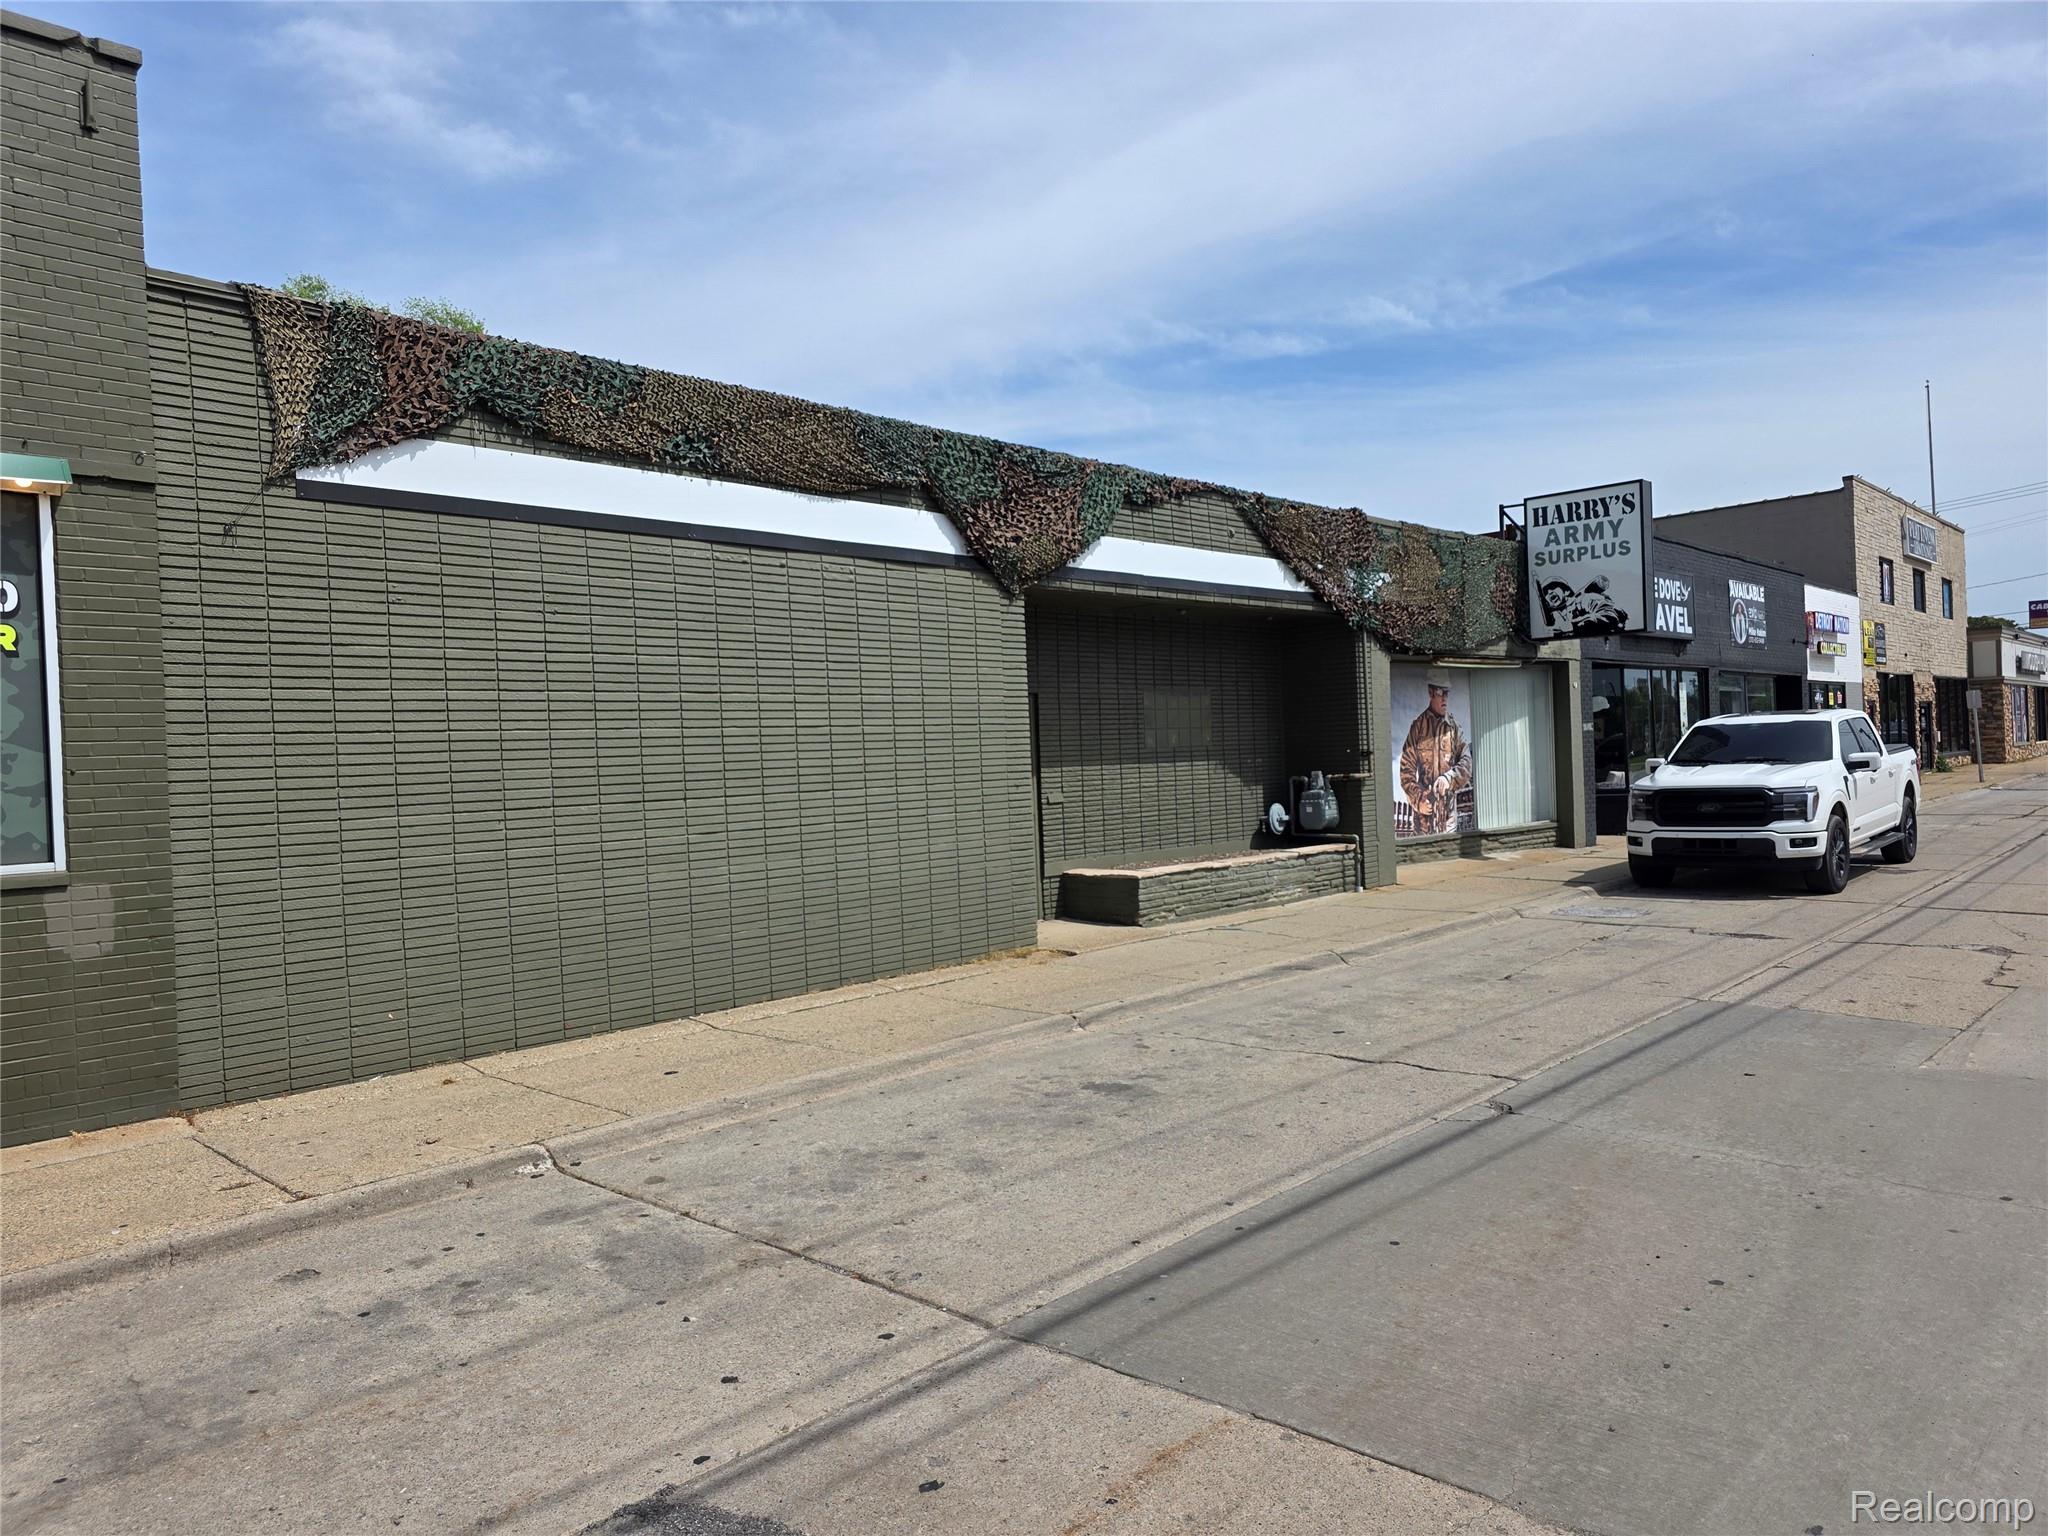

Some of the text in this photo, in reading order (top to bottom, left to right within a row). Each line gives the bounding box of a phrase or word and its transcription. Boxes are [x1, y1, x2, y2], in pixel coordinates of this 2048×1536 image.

[1532, 492, 1636, 528] HARRY'S
[1544, 518, 1624, 548] ARMY
[1534, 540, 1631, 567] SURPLUS
[1728, 579, 1765, 603] AVAILABLE
